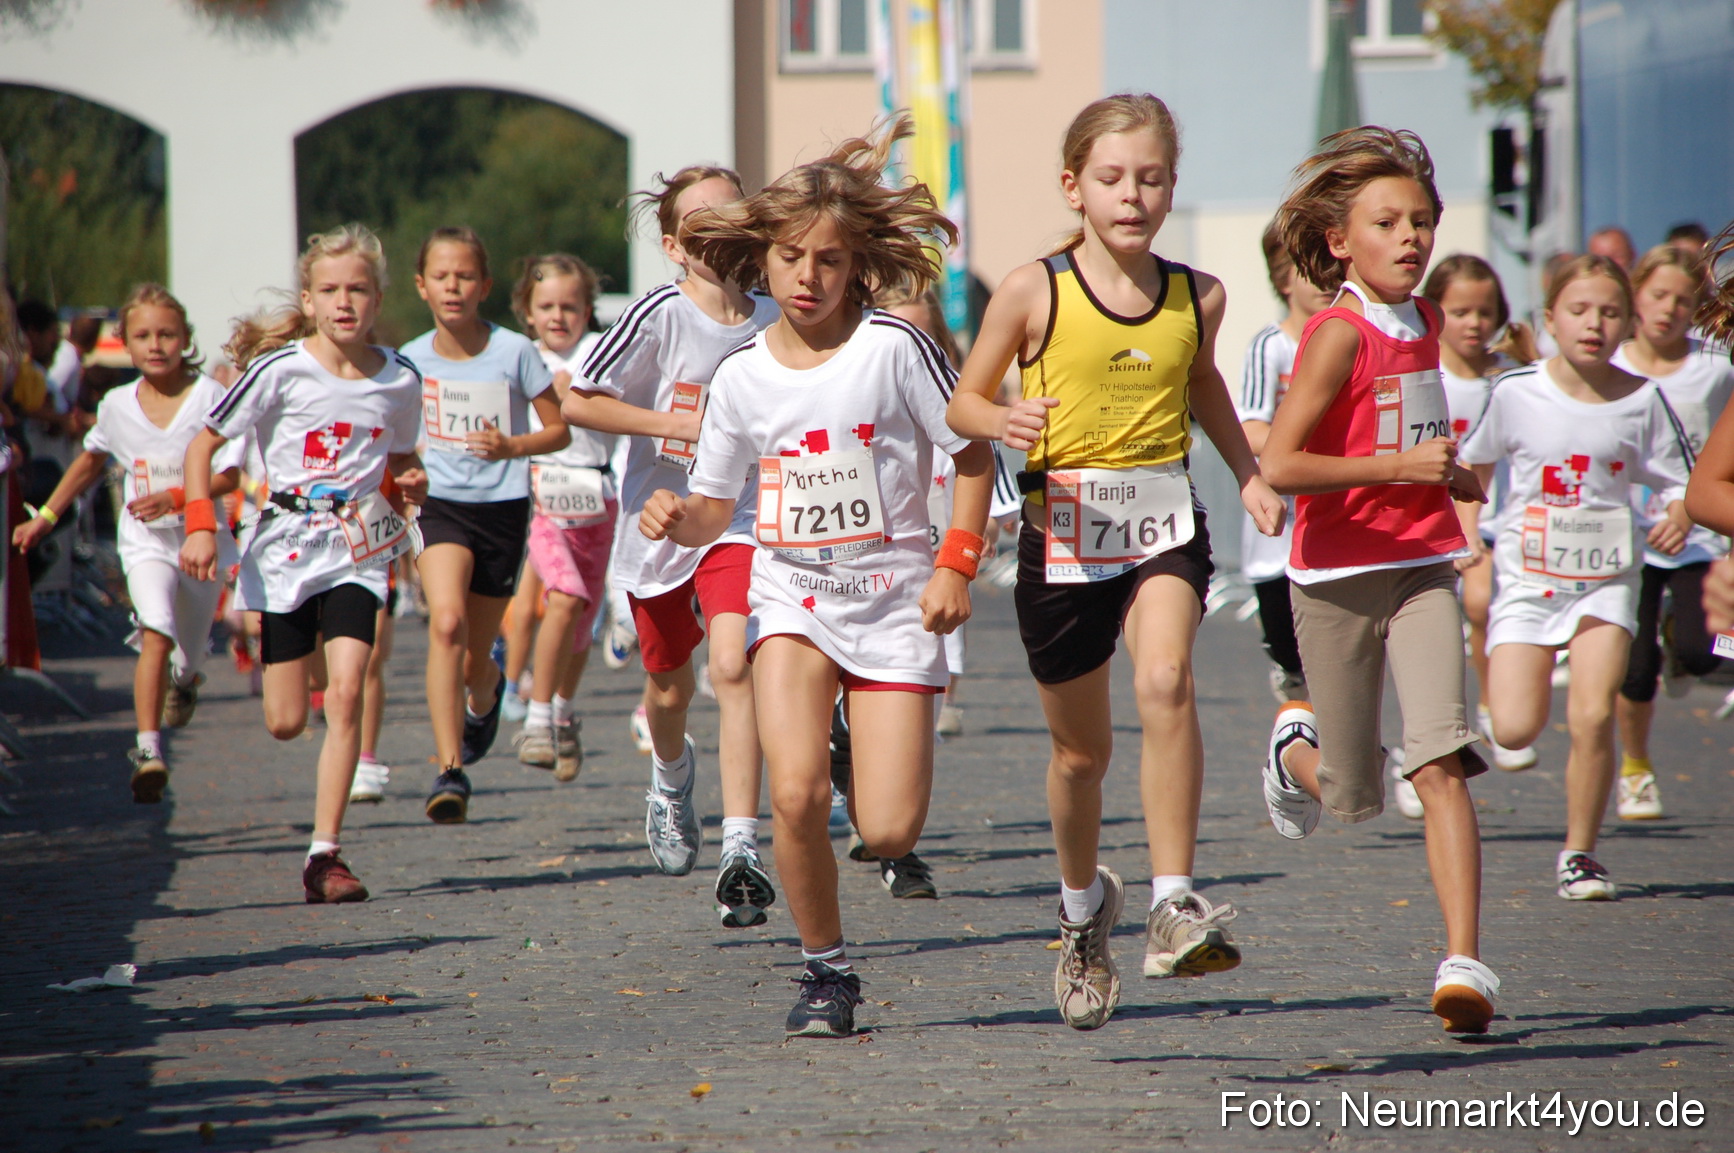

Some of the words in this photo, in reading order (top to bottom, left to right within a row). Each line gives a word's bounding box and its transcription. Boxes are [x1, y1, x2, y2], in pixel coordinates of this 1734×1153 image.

[1108, 362, 1153, 373] skinfit
[443, 387, 470, 402] Anna
[1100, 383, 1111, 392] TV
[1113, 382, 1157, 393] Hilpoltstein
[1110, 394, 1144, 403] Triathlon
[541, 471, 569, 483] Marie
[784, 467, 858, 490] Martha
[1087, 480, 1136, 505] Tanja
[544, 494, 597, 512] 7088
[789, 499, 870, 534] 7219
[1053, 511, 1071, 528] K3
[1091, 513, 1177, 550] 7161
[1552, 517, 1604, 534] Melanie
[833, 538, 883, 554] PFLEIDERER
[1553, 547, 1622, 570] 7104
[1049, 565, 1104, 578] BOCK
